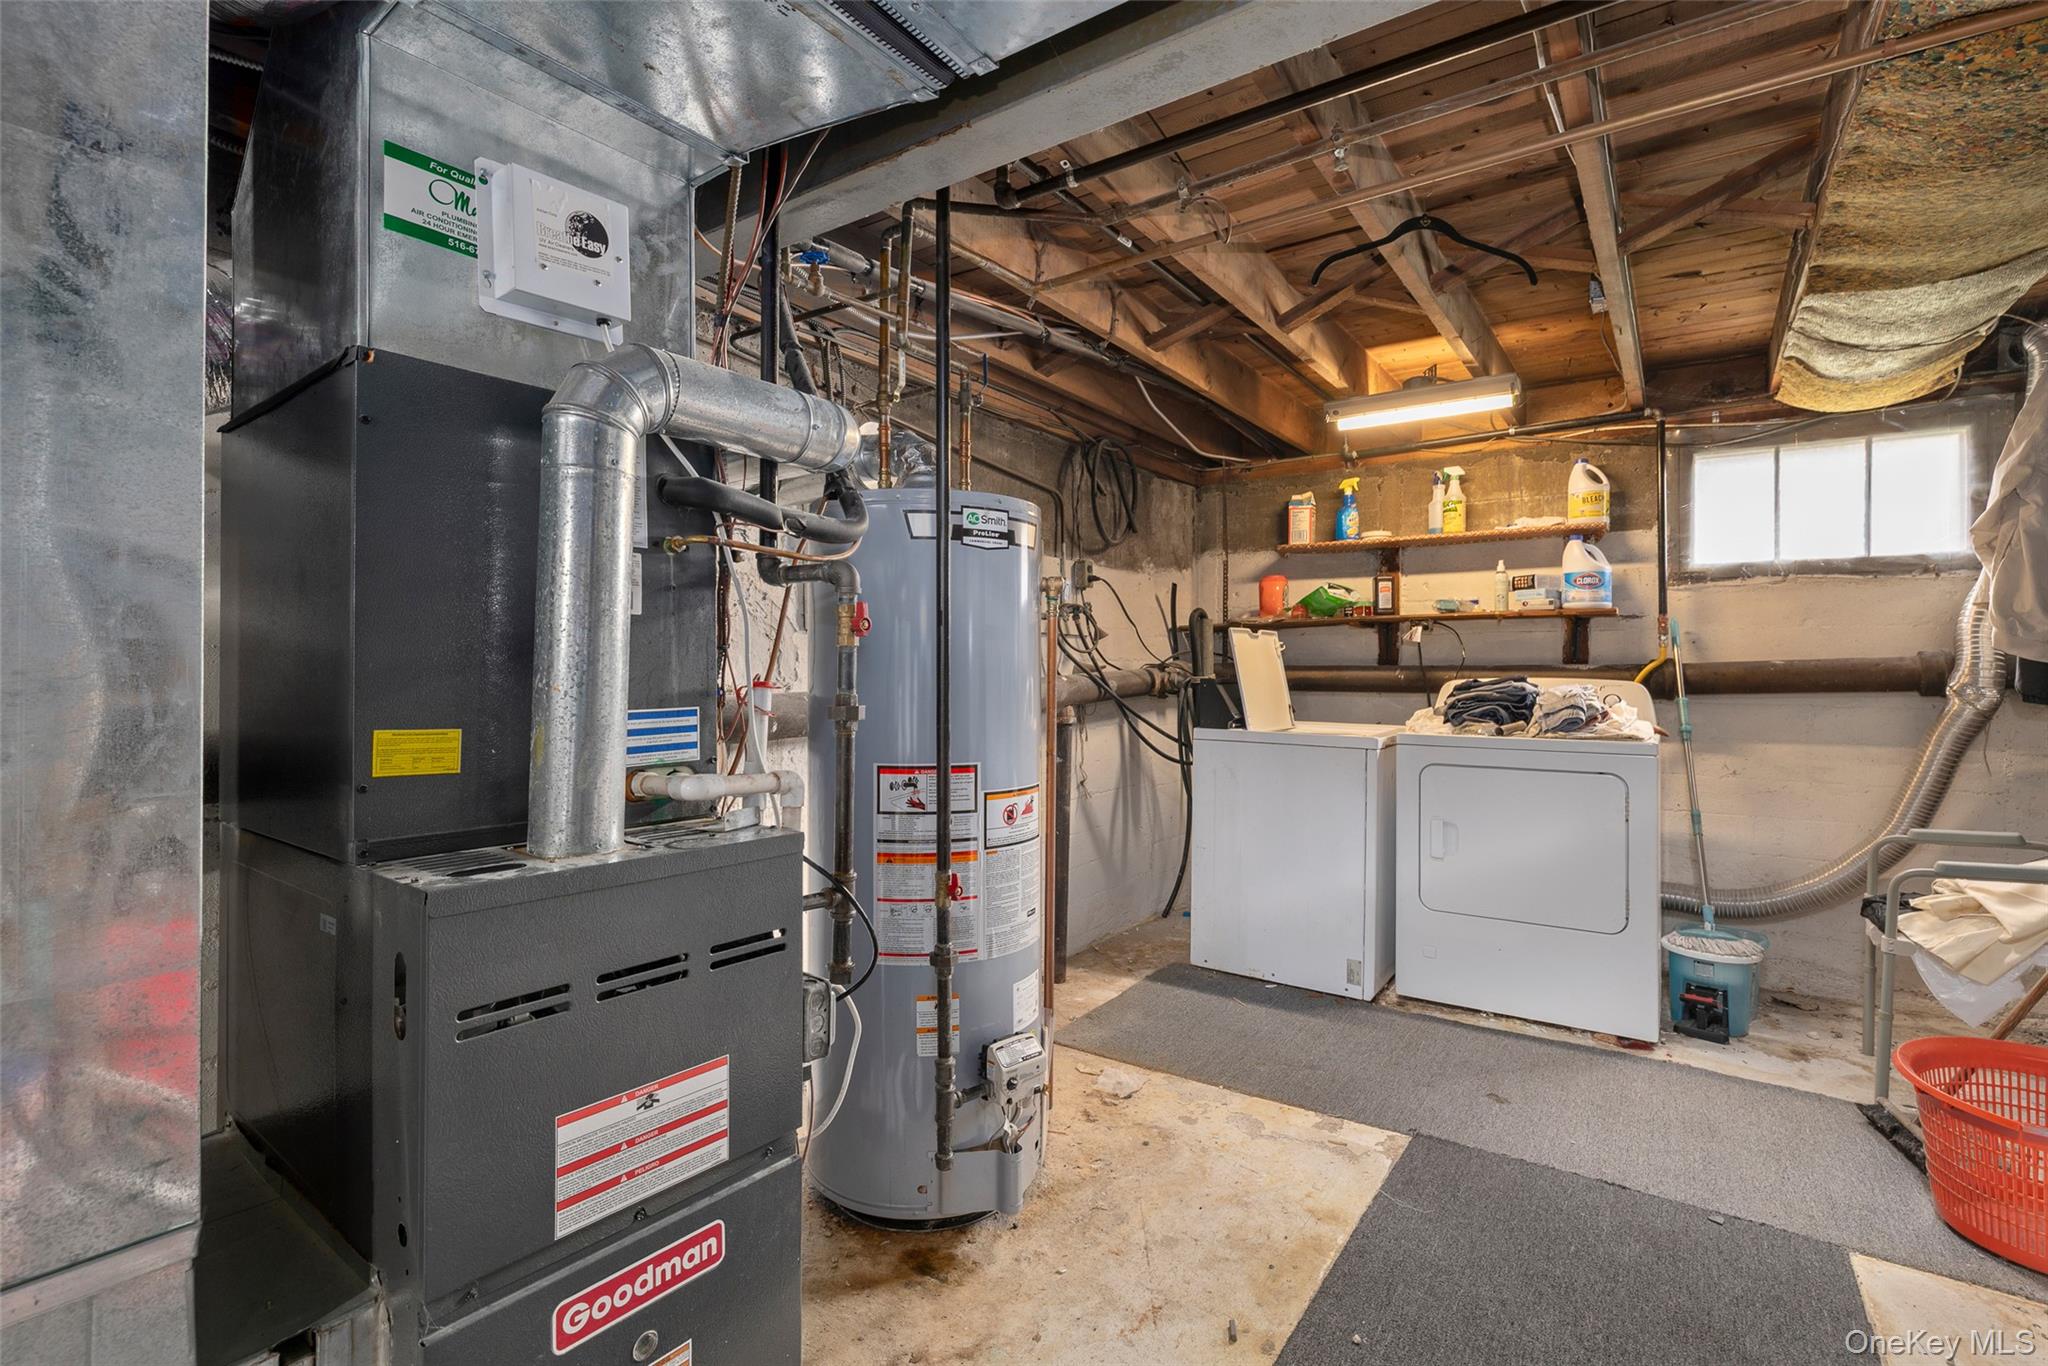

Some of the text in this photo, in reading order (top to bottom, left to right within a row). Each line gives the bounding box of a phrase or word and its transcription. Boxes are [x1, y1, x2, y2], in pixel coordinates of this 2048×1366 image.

[429, 161, 448, 174] For
[410, 207, 425, 217] AIR
[422, 218, 432, 226] 24
[433, 222, 456, 236] HOUR
[448, 238, 478, 254] 516-6
[581, 235, 606, 256] Easy
[981, 515, 1006, 527] Smith
[972, 529, 1001, 538] ProLine
[634, 1083, 659, 1097] DANGER
[634, 1129, 659, 1144] DANGER
[634, 1161, 660, 1176] PELIGRO
[562, 1236, 718, 1335] Goodman
